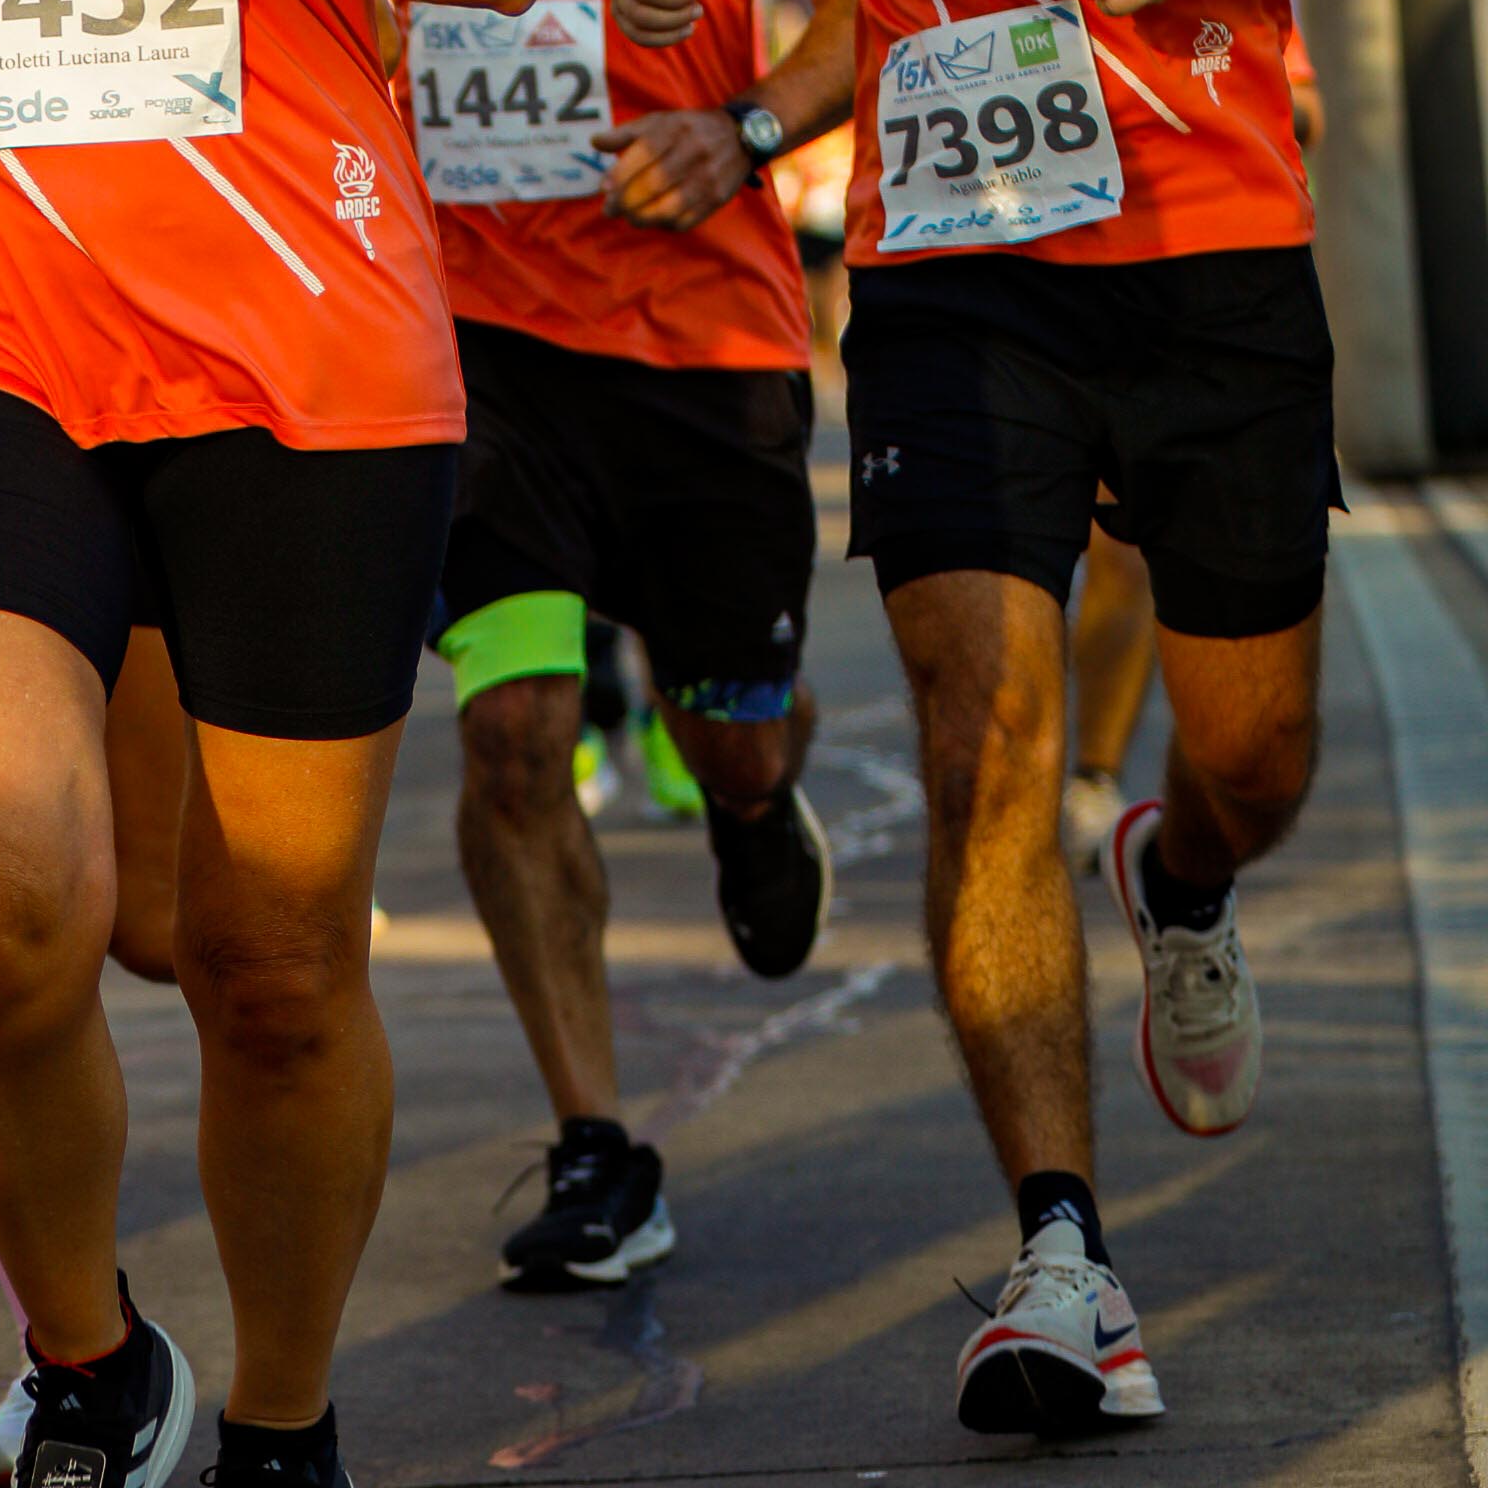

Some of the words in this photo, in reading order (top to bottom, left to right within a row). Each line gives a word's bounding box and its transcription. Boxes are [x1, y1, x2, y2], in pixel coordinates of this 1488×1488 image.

[423, 22, 466, 49] 15K
[1016, 32, 1051, 56] 10K
[58, 47, 131, 67] Luciana
[137, 44, 190, 62] Laura
[417, 62, 600, 128] 1442
[884, 79, 1099, 187] 7398
[1000, 166, 1042, 187] Pablo
[336, 196, 380, 220] ARDEC
